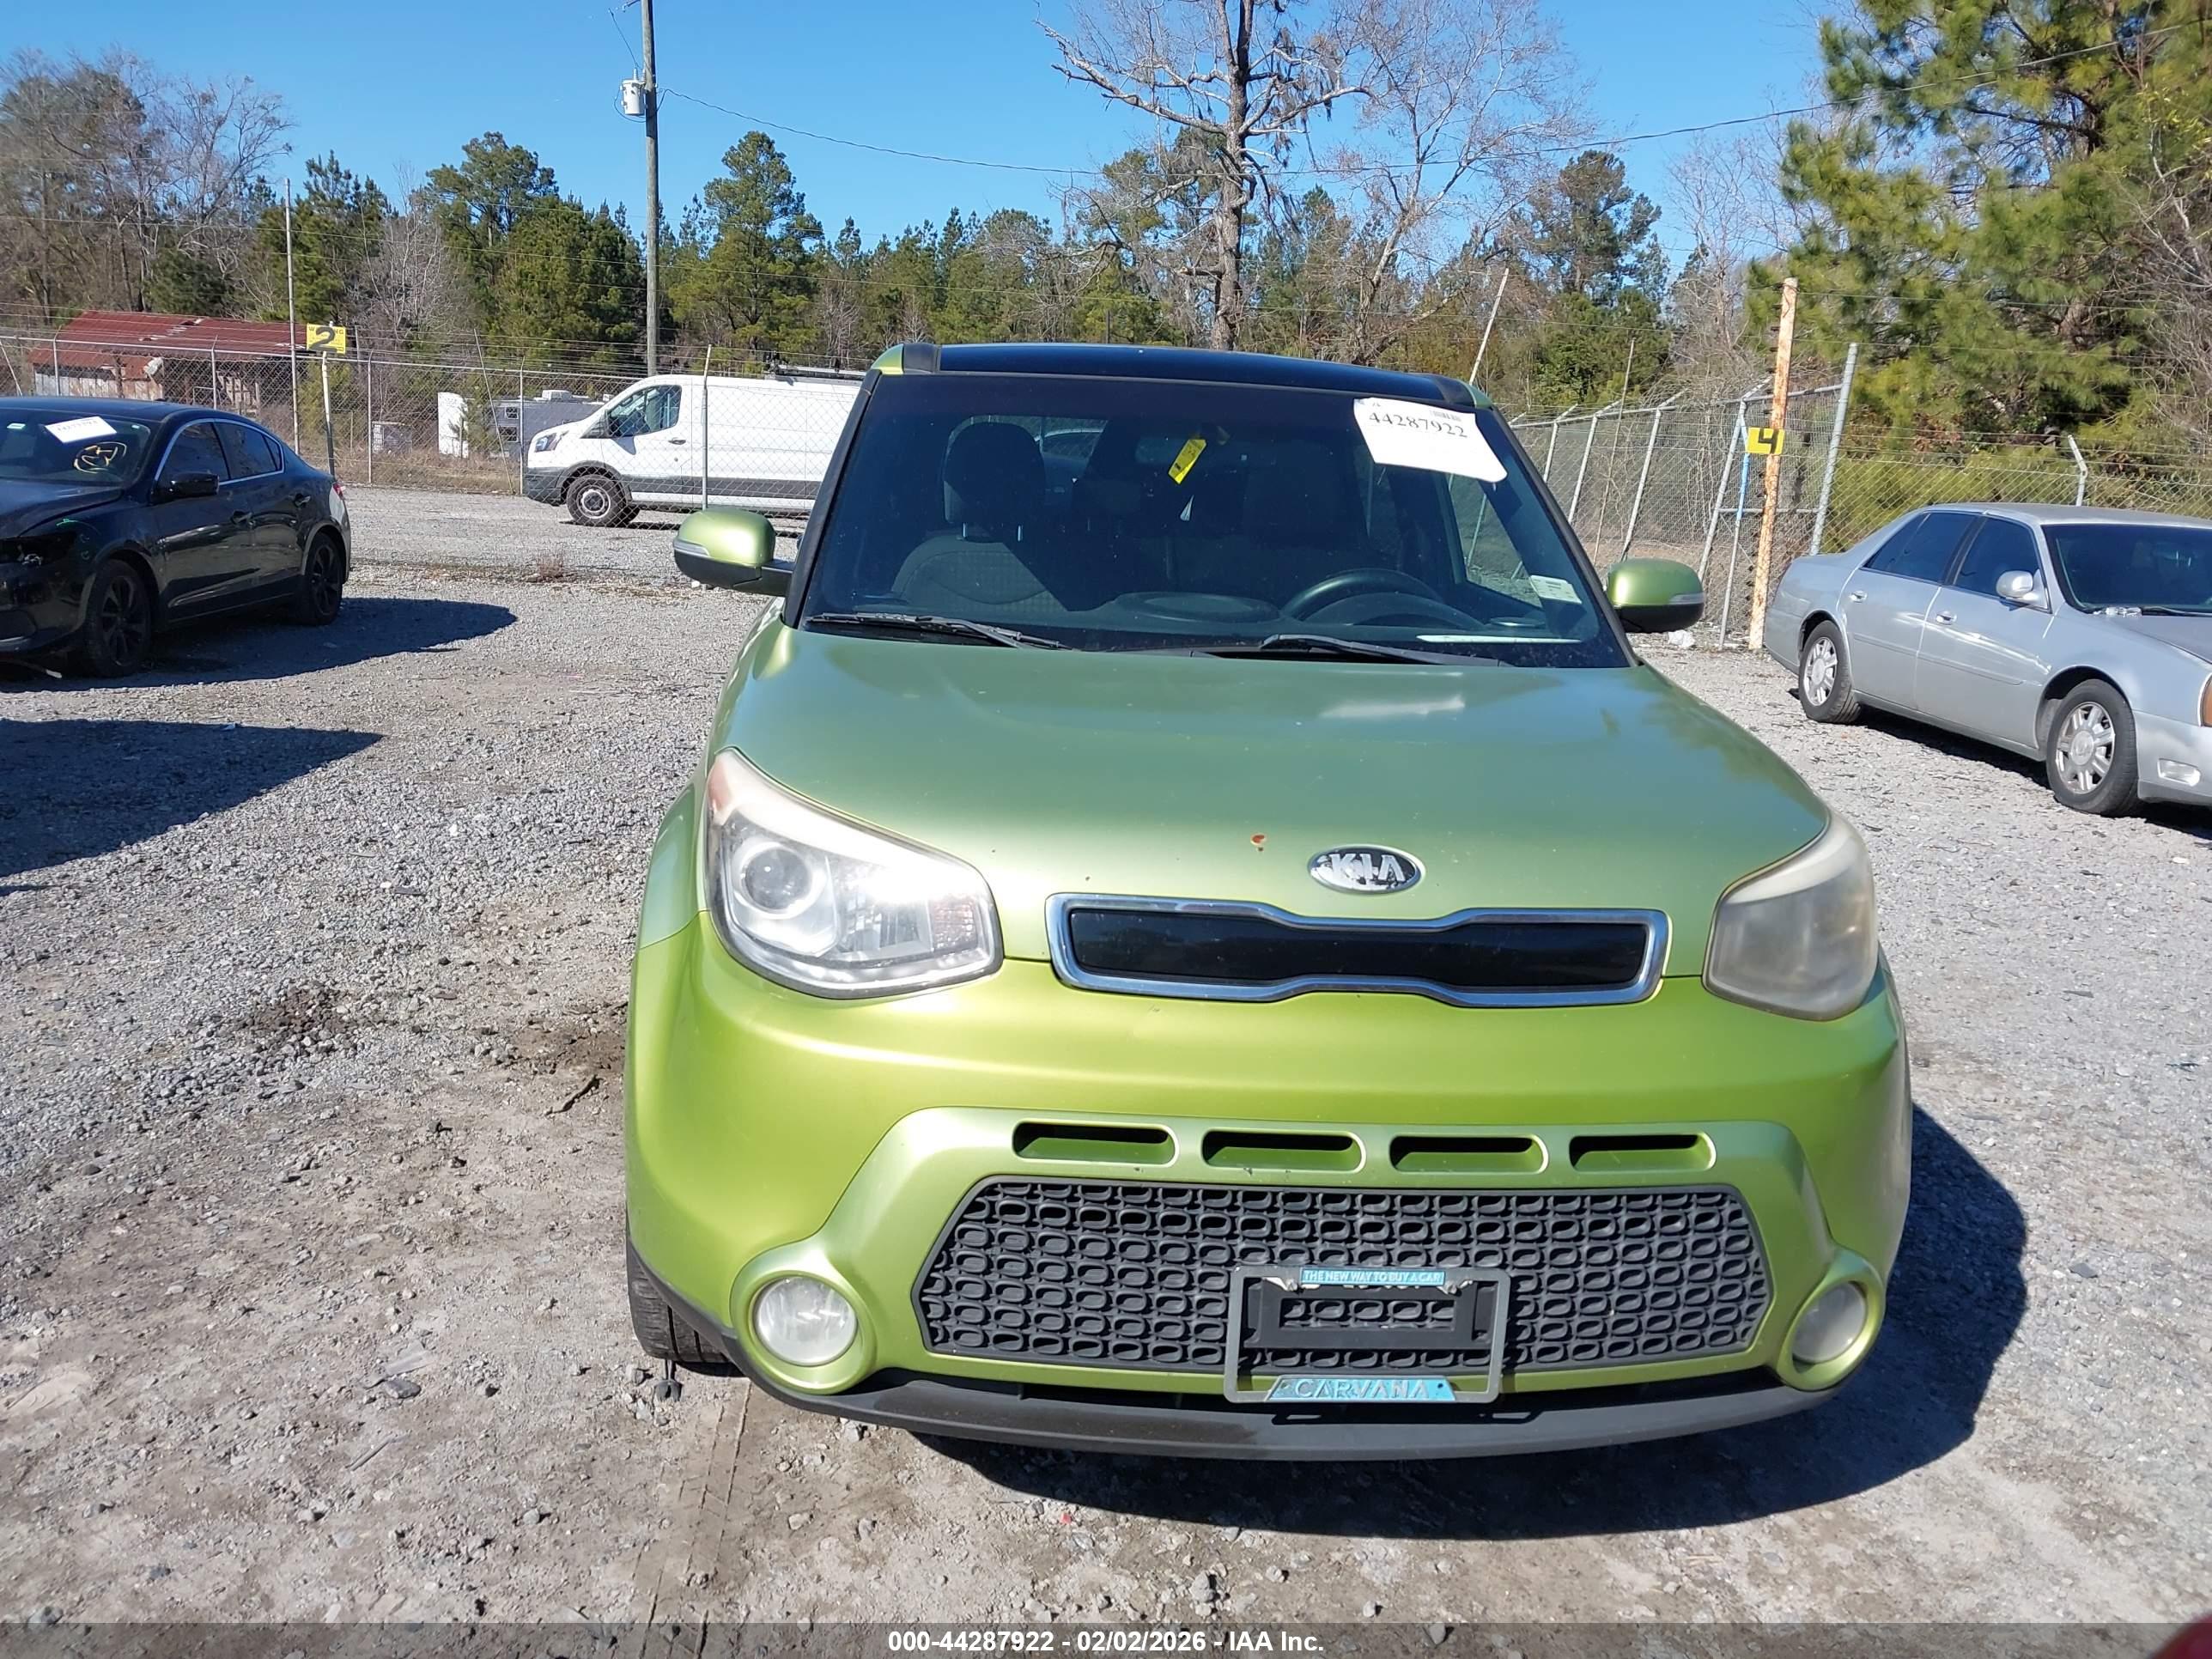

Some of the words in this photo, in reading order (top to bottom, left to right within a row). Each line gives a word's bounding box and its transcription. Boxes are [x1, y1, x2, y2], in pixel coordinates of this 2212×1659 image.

[308, 326, 337, 352] 2
[1369, 411, 1468, 439] 44287922
[1758, 428, 1780, 453] 4
[1328, 853, 1407, 883] KIA
[1304, 1270, 1325, 1281] THE
[1326, 1271, 1350, 1281] NEW
[1351, 1271, 1372, 1281] WAY
[1374, 1271, 1388, 1281] TO
[1389, 1271, 1409, 1281] BUY
[1410, 1272, 1419, 1282] A
[1419, 1272, 1443, 1282] CAR
[1295, 1379, 1429, 1399] CARVANA
